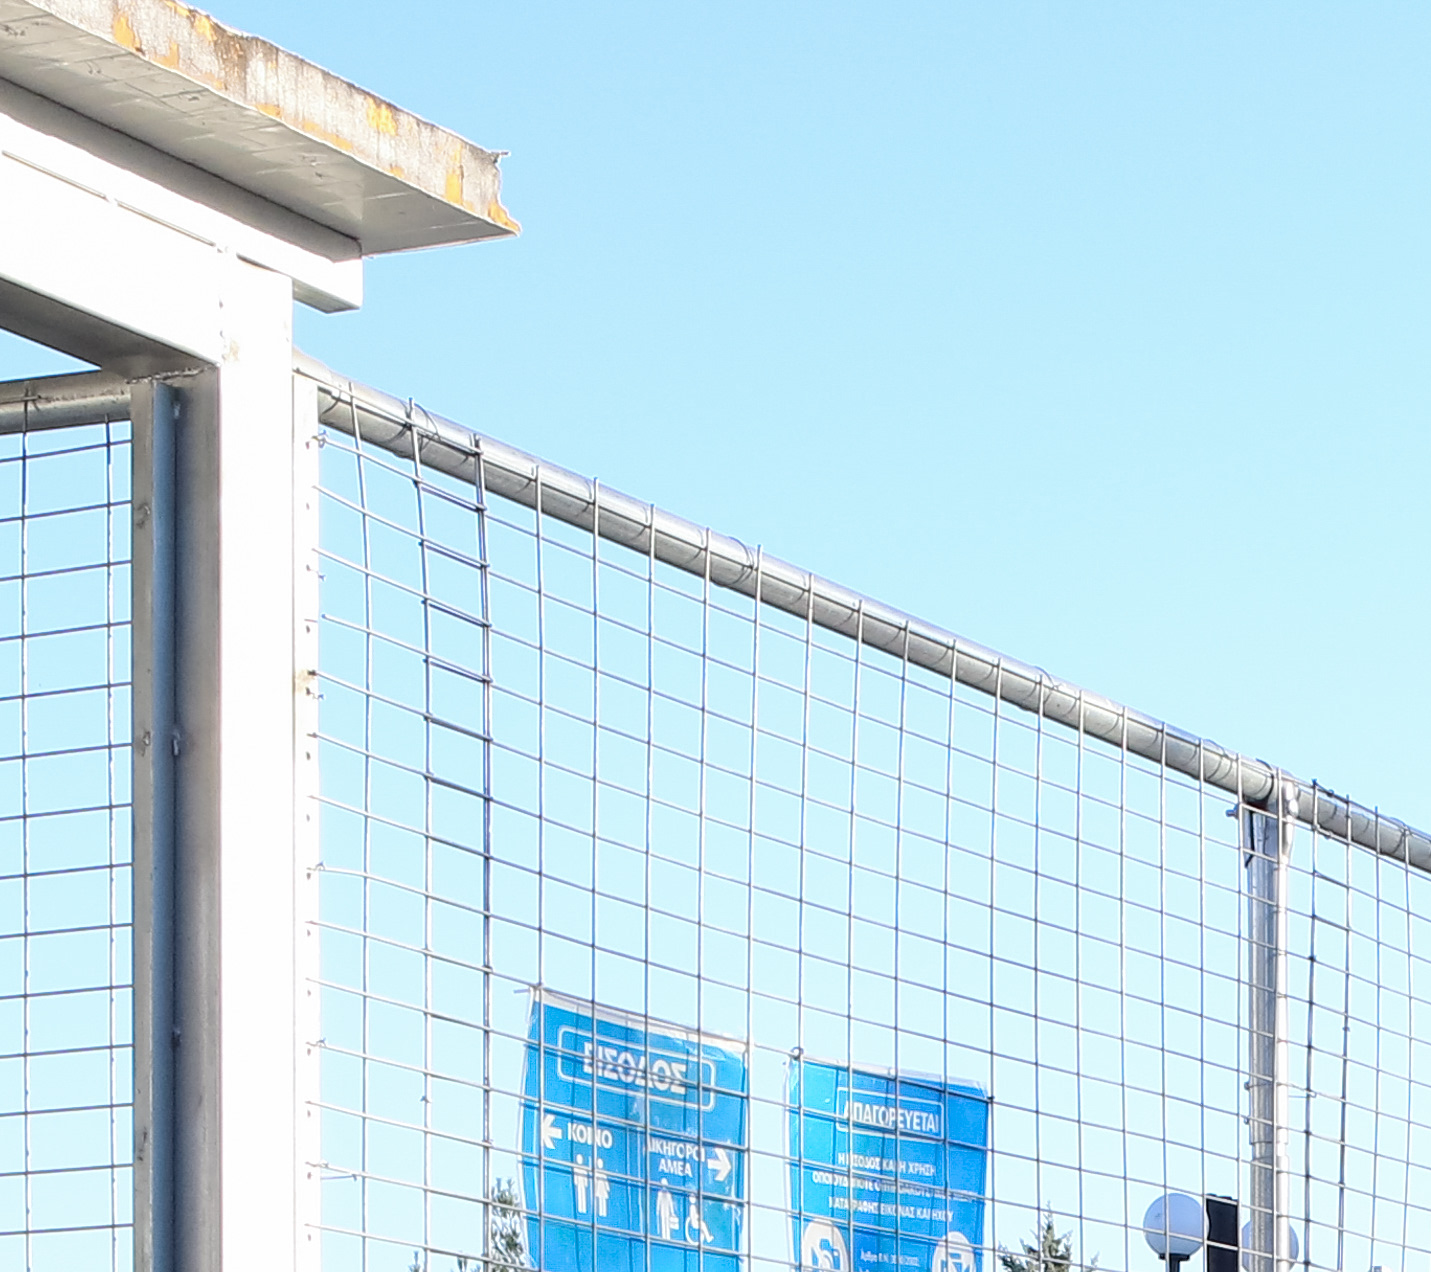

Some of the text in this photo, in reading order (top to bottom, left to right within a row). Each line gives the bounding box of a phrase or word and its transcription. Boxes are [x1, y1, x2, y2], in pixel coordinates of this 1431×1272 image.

[583, 1041, 688, 1095] ΕΙΣΟΔΟΣ
[567, 1121, 613, 1149] ΚΟΙΝΟ
[658, 1158, 693, 1178] ΑΜΕΑ
